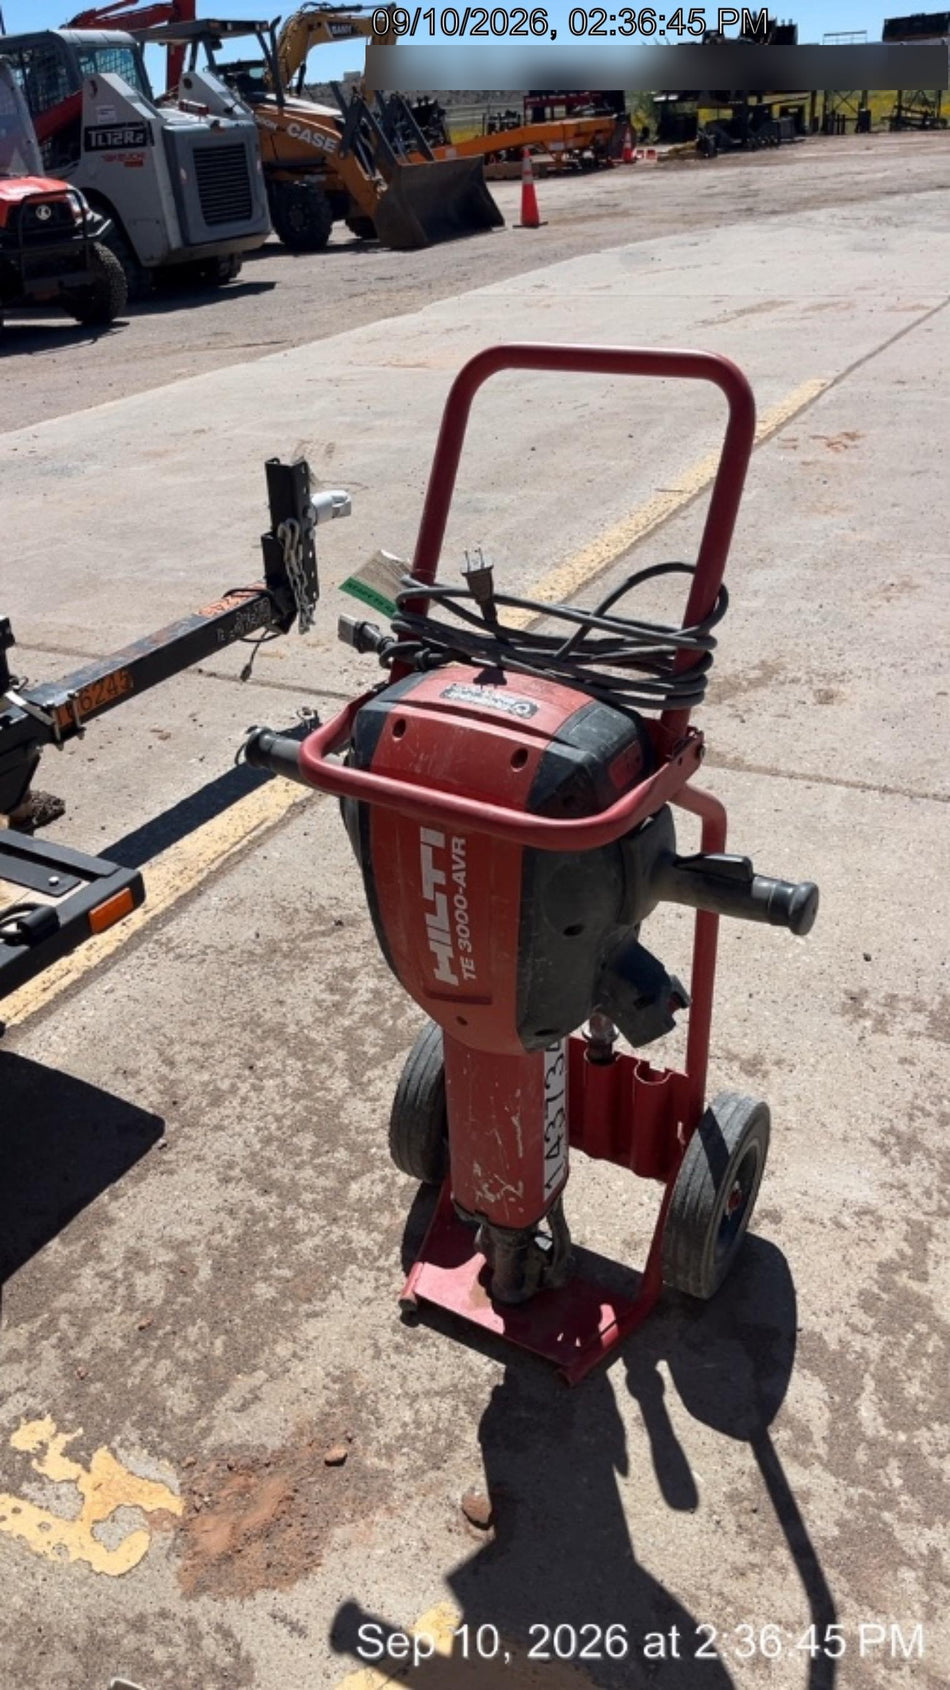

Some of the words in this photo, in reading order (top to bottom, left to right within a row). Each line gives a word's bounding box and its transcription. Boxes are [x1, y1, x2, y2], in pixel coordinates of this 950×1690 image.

[286, 122, 338, 153] CASE
[420, 826, 459, 987] HILTI
[452, 836, 473, 953] 3000-AVR
[460, 956, 477, 981] TE
